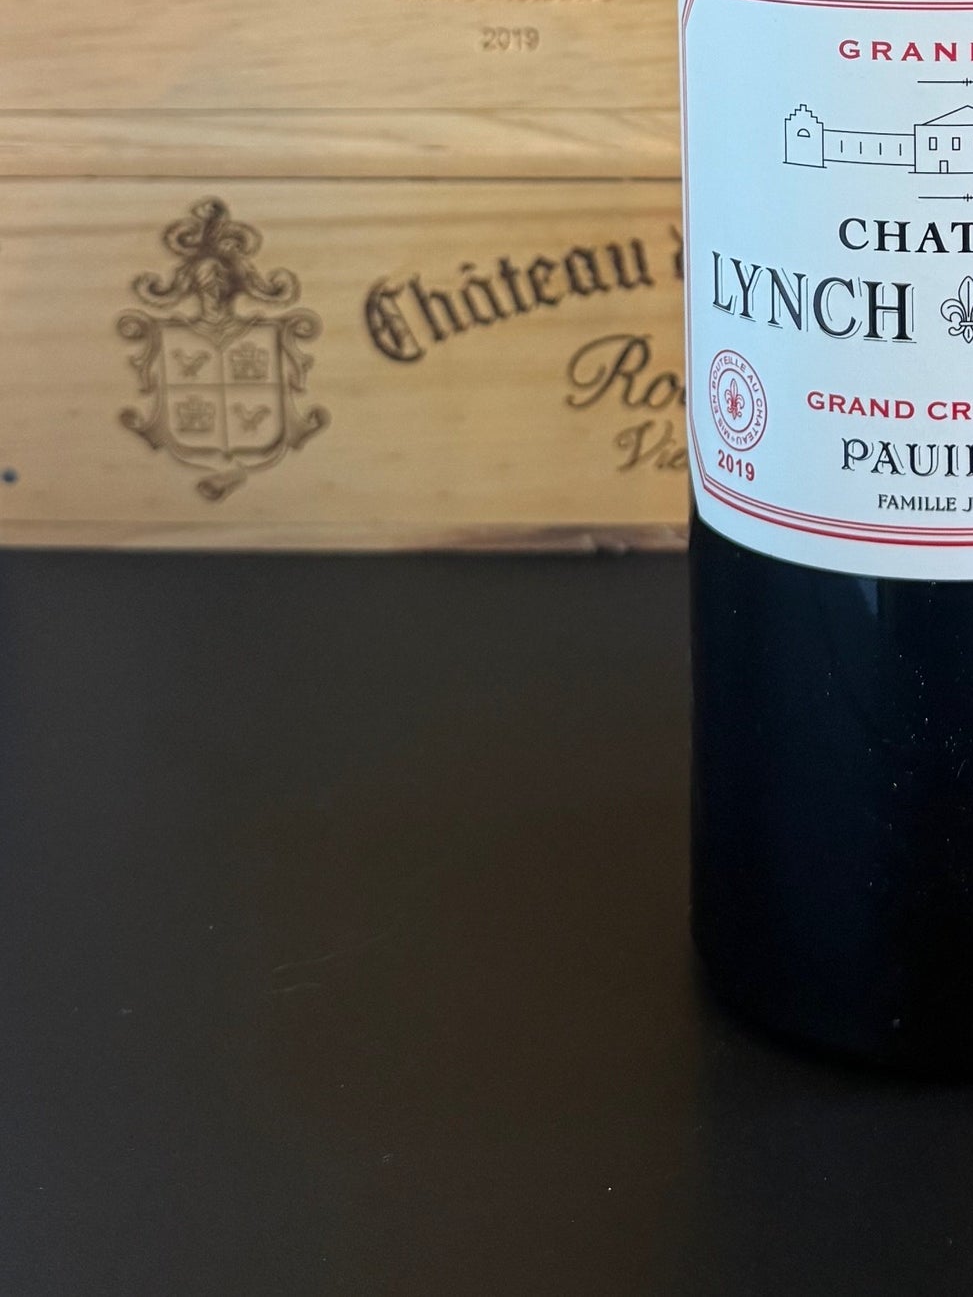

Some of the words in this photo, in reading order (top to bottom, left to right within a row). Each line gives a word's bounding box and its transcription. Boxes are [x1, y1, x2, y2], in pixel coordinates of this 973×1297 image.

[481, 27, 540, 52] 2019
[364, 237, 654, 364] Château
[712, 250, 917, 344] LYNCH
[565, 333, 687, 410] Ro
[711, 356, 746, 389] BOUTEILLE
[747, 374, 760, 393] AU
[711, 394, 719, 414] EN
[807, 390, 915, 420] GRAND
[717, 417, 731, 440] MIS
[736, 397, 763, 446] CHATEAU
[717, 448, 756, 482] 2019
[877, 493, 957, 511] FAMILLE
